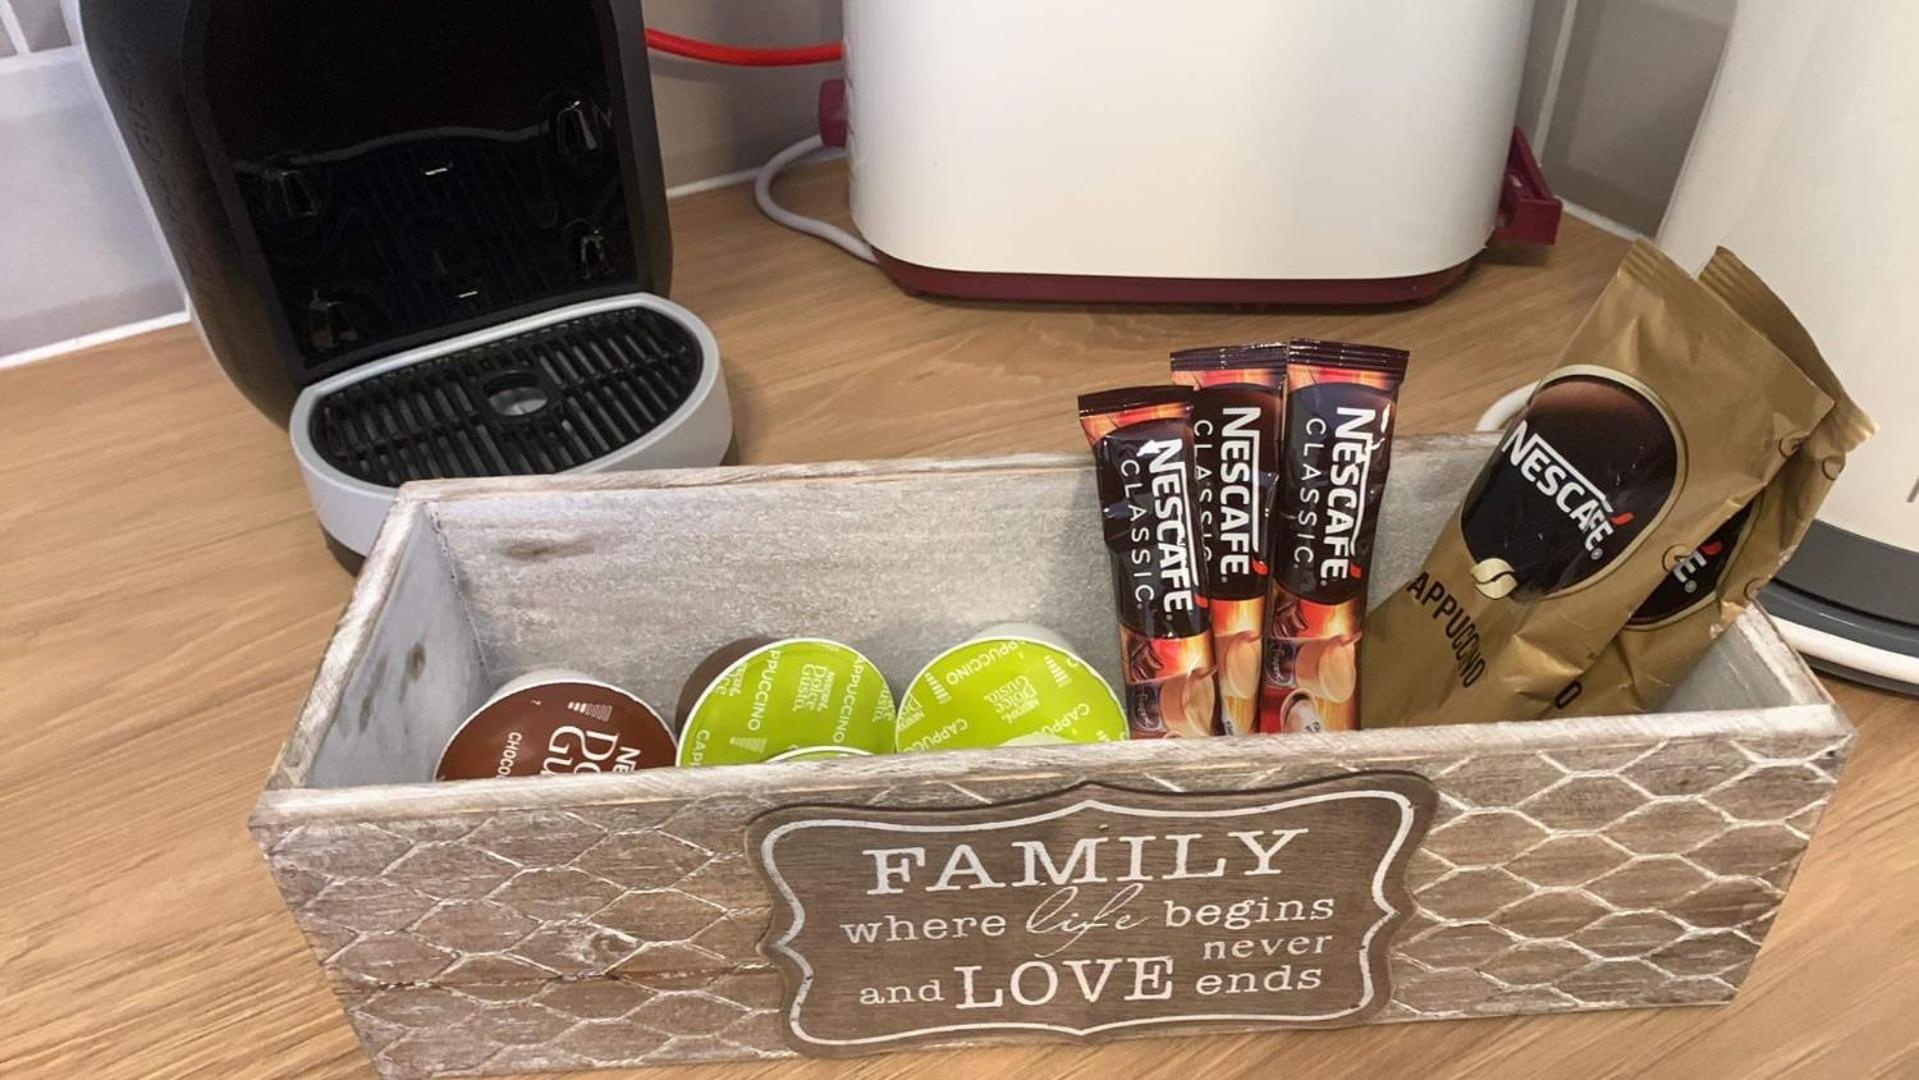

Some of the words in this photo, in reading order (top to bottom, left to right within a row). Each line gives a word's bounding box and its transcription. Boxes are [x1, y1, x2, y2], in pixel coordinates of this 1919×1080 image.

[1293, 417, 1327, 564] CLASSIC
[1120, 459, 1155, 603] CLASSIC
[1406, 571, 1486, 688] APPUCCINO
[748, 650, 781, 731] PPUCCINO
[833, 656, 868, 743] APPUCCINO
[497, 731, 523, 778] CHOCO
[862, 827, 1309, 895] FAMILY
[840, 911, 1007, 945] where
[1024, 883, 1151, 957] life
[1164, 897, 1335, 929] begins
[1202, 933, 1333, 962] never
[859, 979, 945, 1007] and
[953, 956, 1175, 1011] LOVE
[1195, 966, 1322, 996] ends
